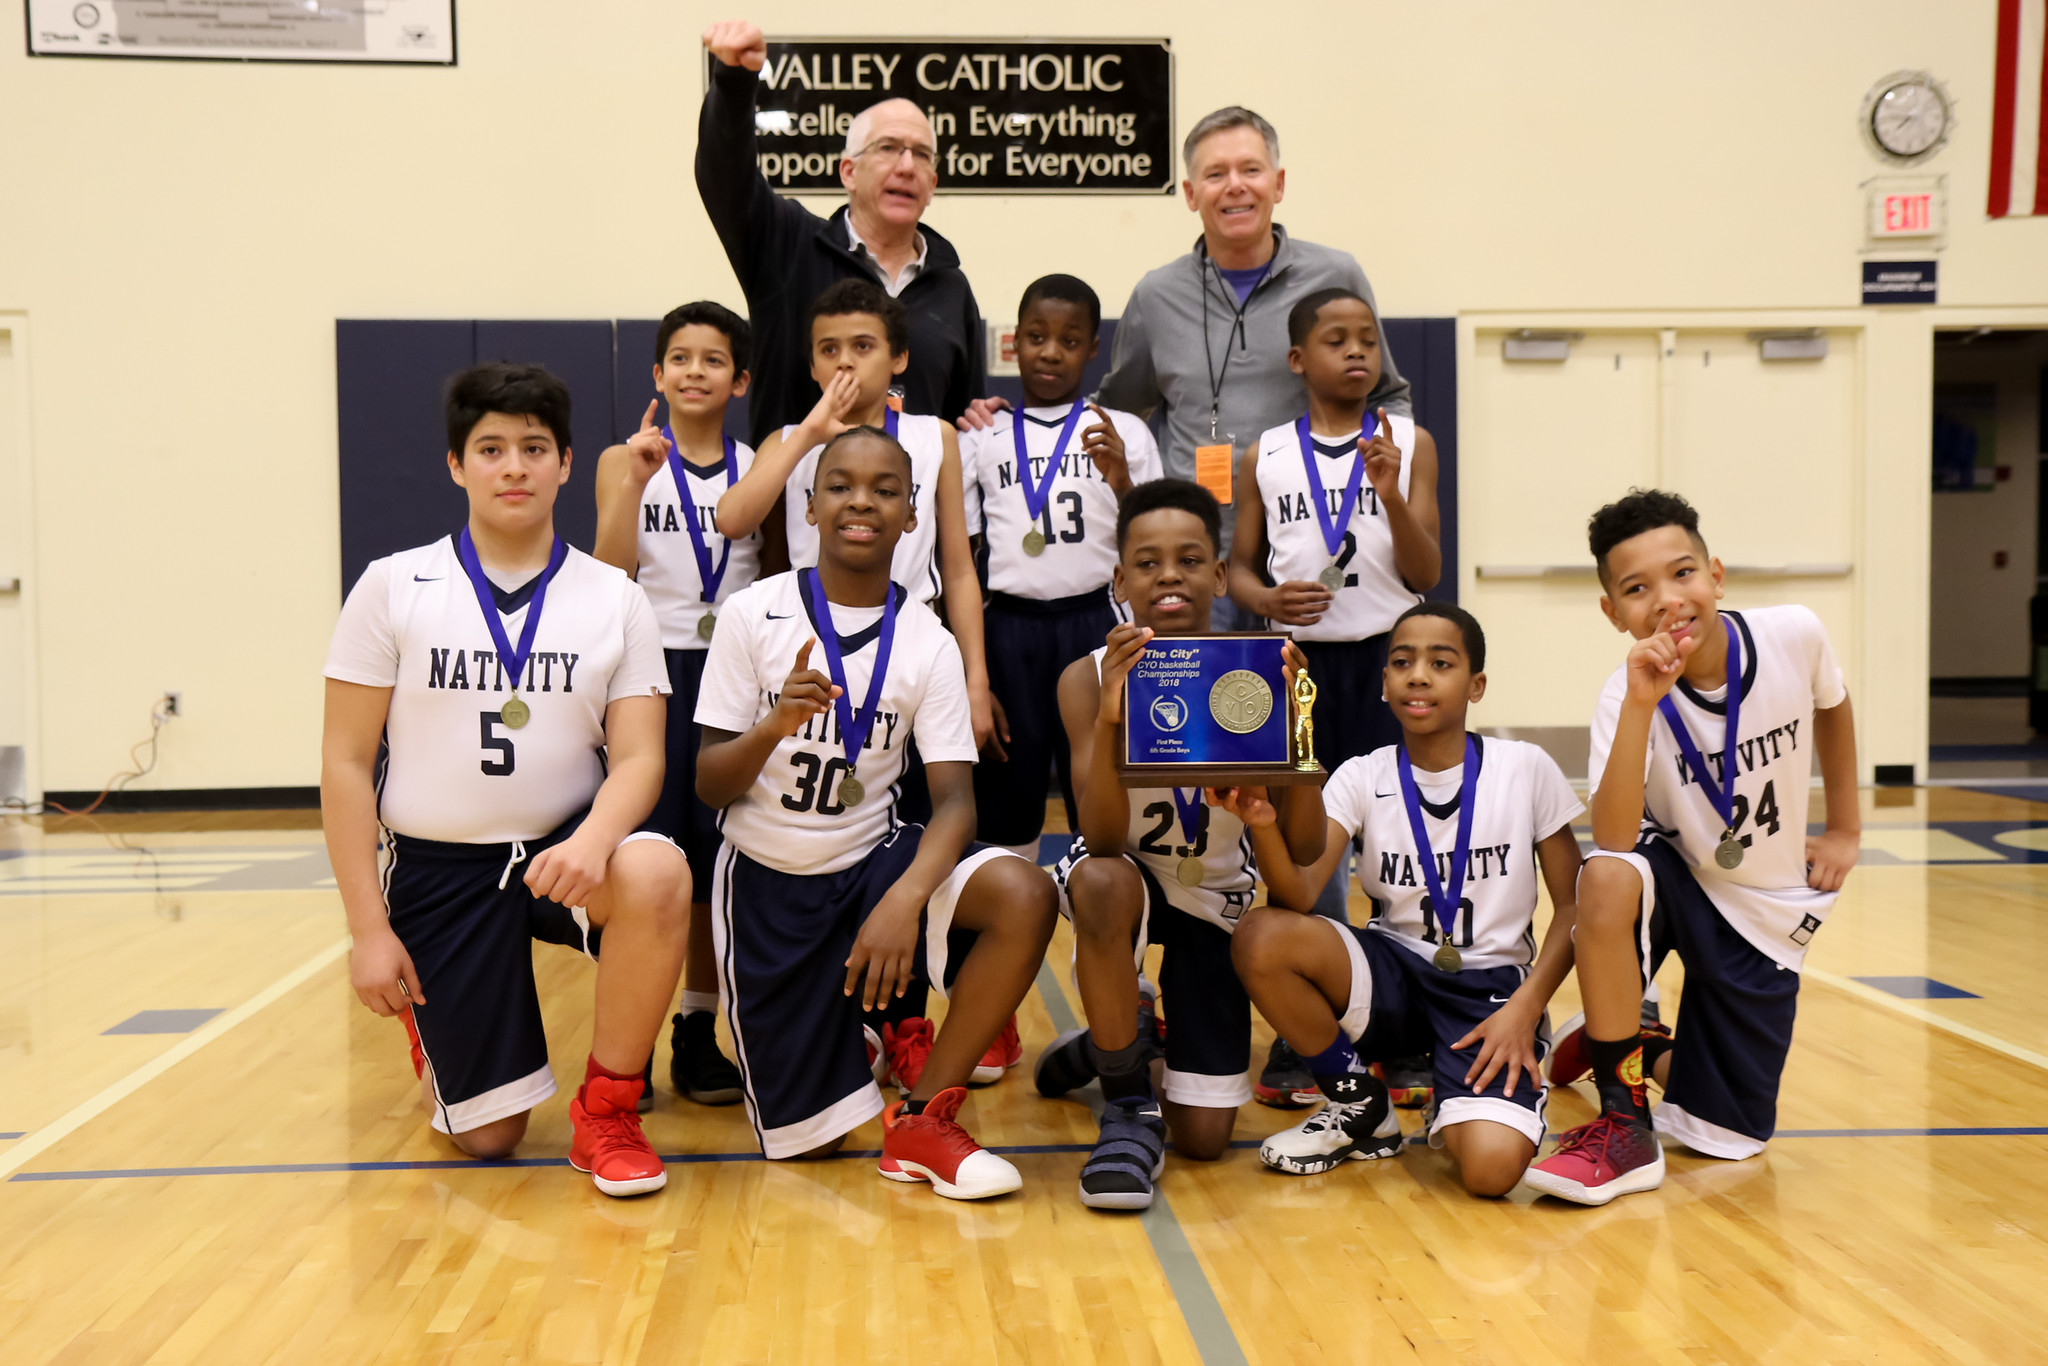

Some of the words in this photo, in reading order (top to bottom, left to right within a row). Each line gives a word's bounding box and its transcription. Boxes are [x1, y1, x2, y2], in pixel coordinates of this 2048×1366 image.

[759, 54, 901, 90] VALLEY
[916, 53, 1123, 92] CATHOLIC
[928, 105, 956, 136] in
[969, 104, 1137, 147] Everything
[945, 143, 993, 176] for
[1006, 145, 1152, 185] Everyone
[1884, 194, 1932, 232] EXIT
[1041, 491, 1085, 545] 13
[1334, 531, 1358, 587] 2
[428, 648, 579, 692] NATIITY
[1137, 661, 1158, 669] CYO
[1159, 660, 1201, 669] basketball
[1137, 670, 1200, 680] Championships
[1170, 649, 1200, 660] City"
[1158, 679, 1180, 687] 2018
[480, 711, 516, 776] 5
[1675, 718, 1800, 787] NTVITY
[780, 751, 857, 816] 30
[1720, 779, 1780, 849] 24
[1379, 844, 1511, 887] NAIITY
[1419, 895, 1474, 948] 10
